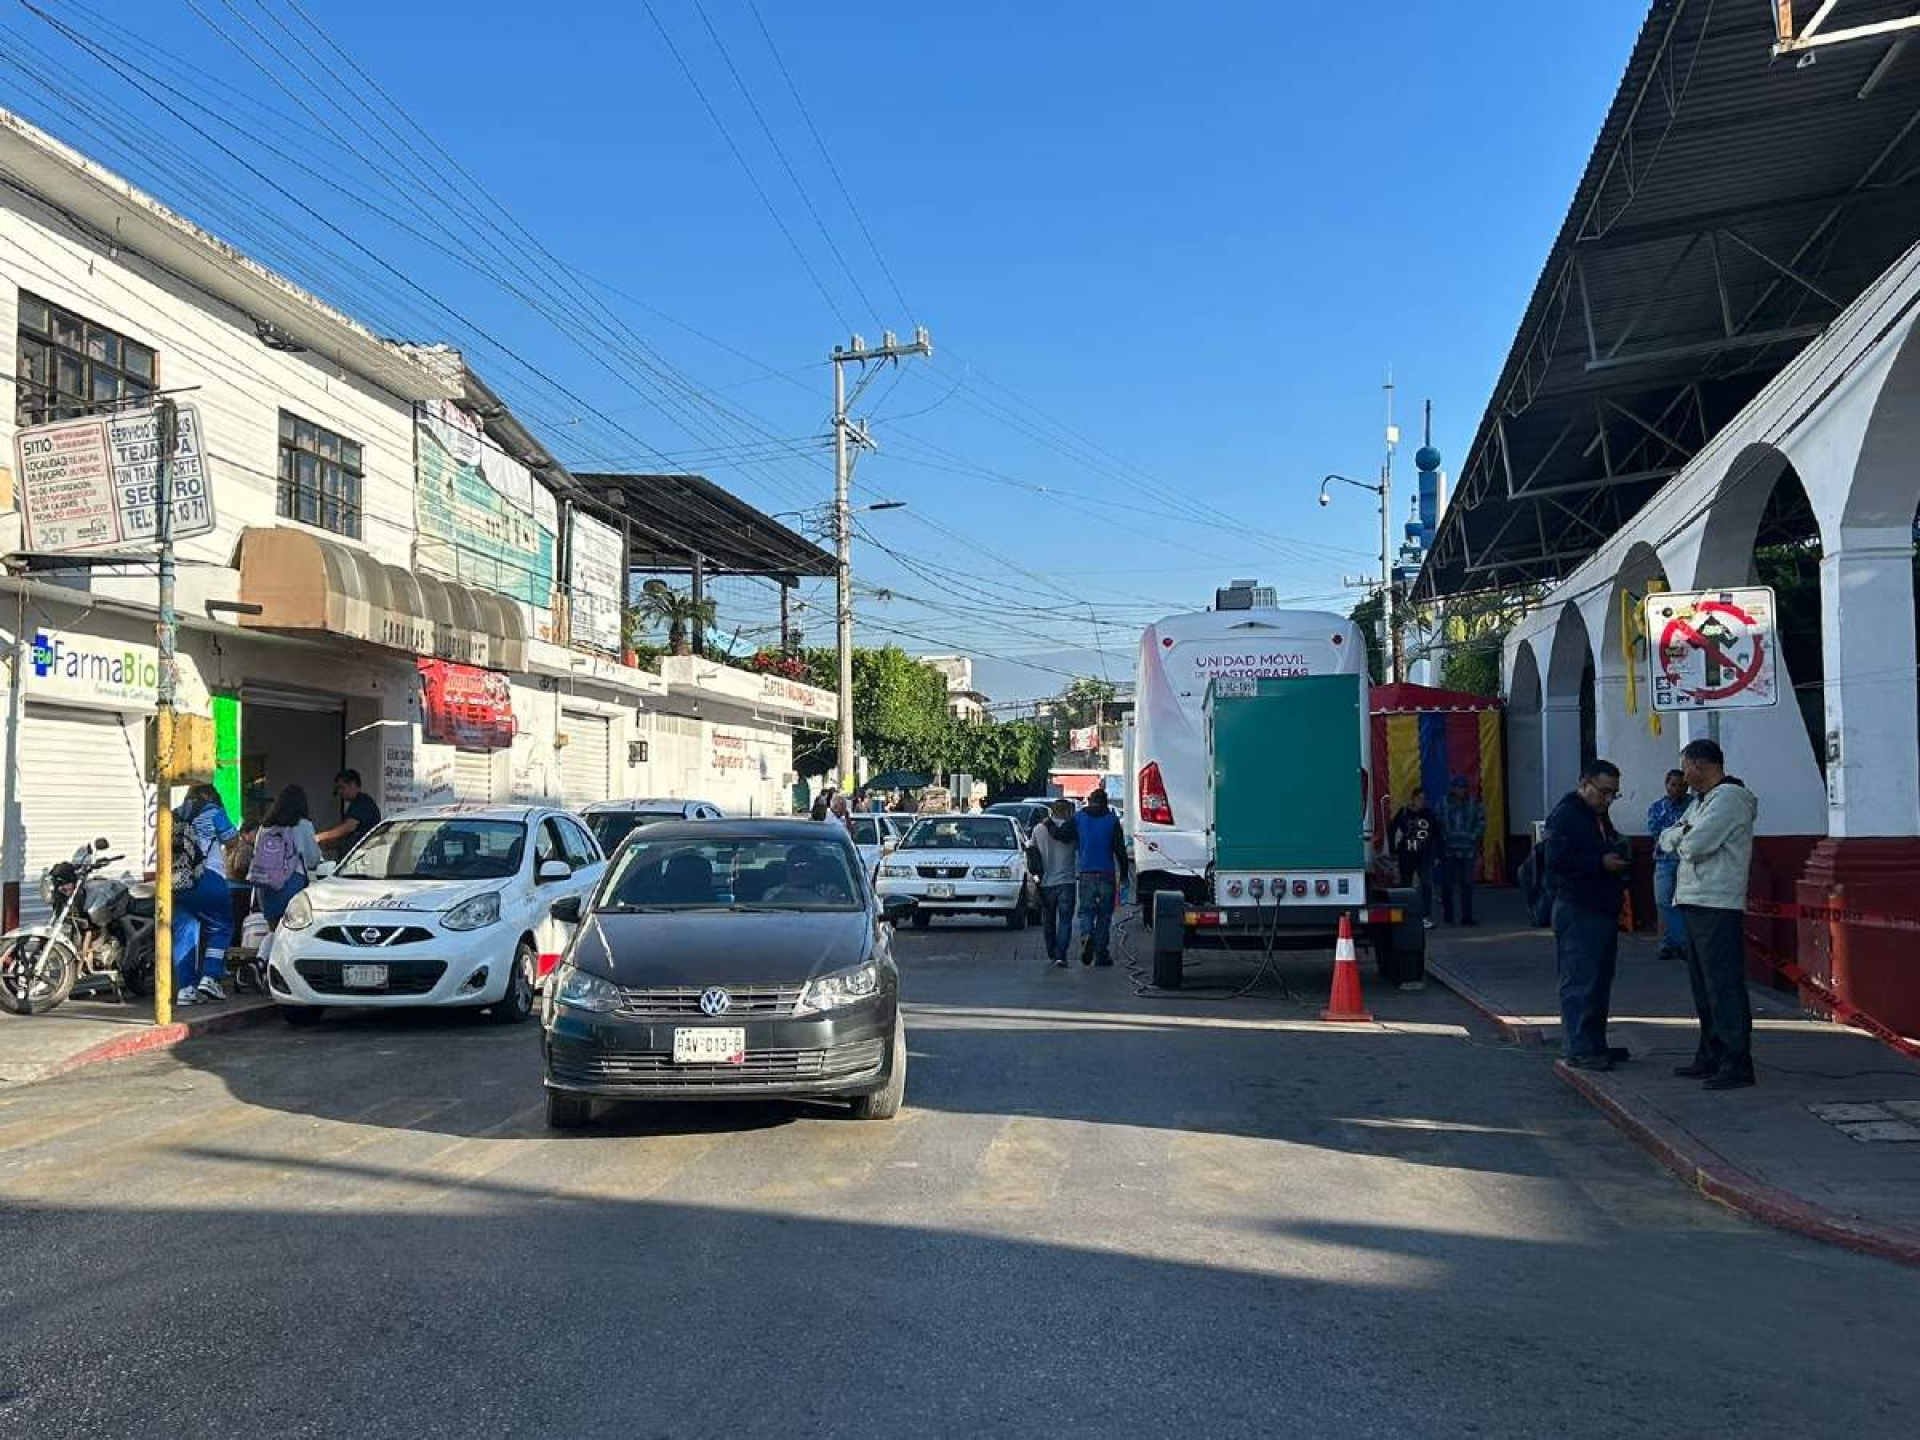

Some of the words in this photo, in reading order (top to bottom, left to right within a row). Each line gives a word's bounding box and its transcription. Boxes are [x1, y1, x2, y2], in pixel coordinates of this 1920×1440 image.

[24, 437, 52, 456] SITIO
[54, 639, 156, 688] FarmaBio
[1196, 655, 1255, 668] UNIDAD
[1260, 652, 1309, 666] MÓVIL
